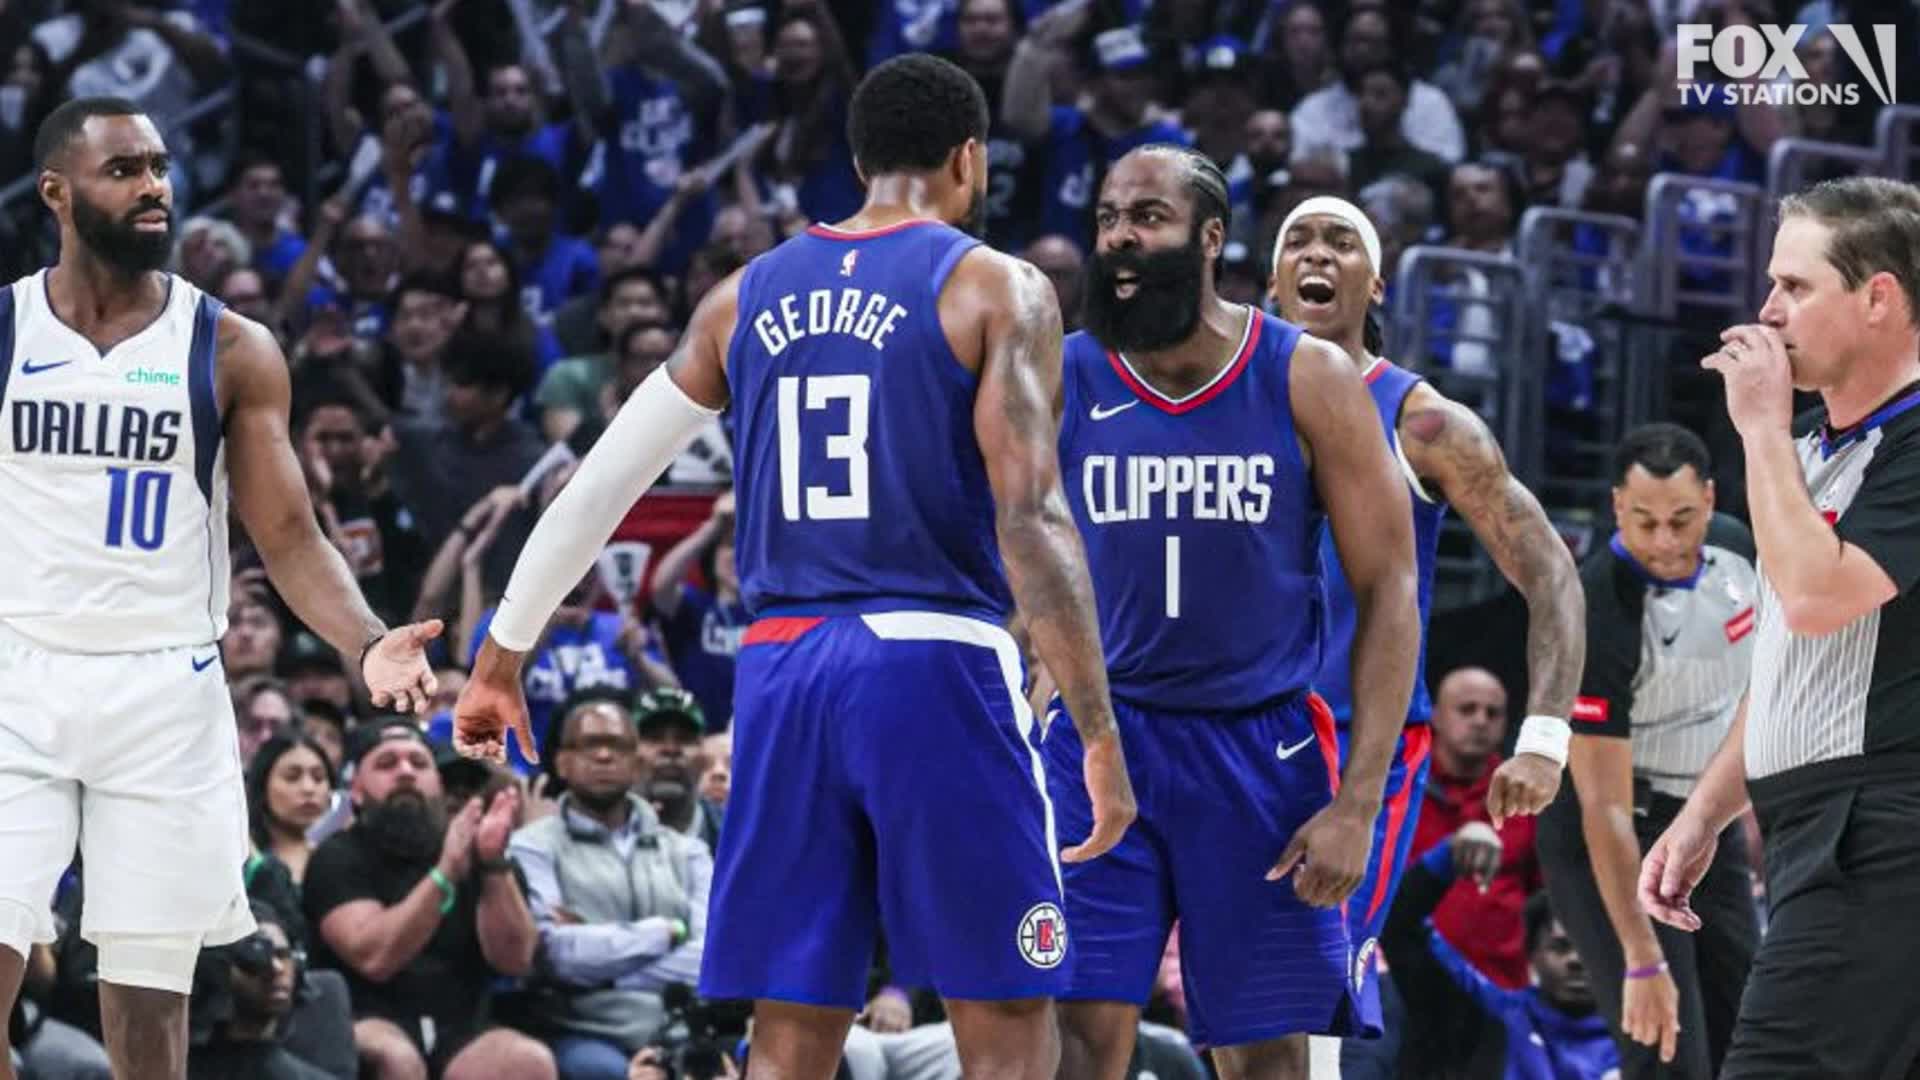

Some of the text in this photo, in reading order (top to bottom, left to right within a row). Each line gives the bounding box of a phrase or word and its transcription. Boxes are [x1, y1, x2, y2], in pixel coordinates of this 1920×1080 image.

[754, 288, 908, 357] GEORGE
[125, 367, 181, 385] chime
[12, 400, 183, 462] DALLAS
[777, 374, 871, 521] 13
[105, 466, 173, 551] 10
[1083, 454, 1275, 524] CLIPPERS
[1166, 536, 1180, 618] 1
